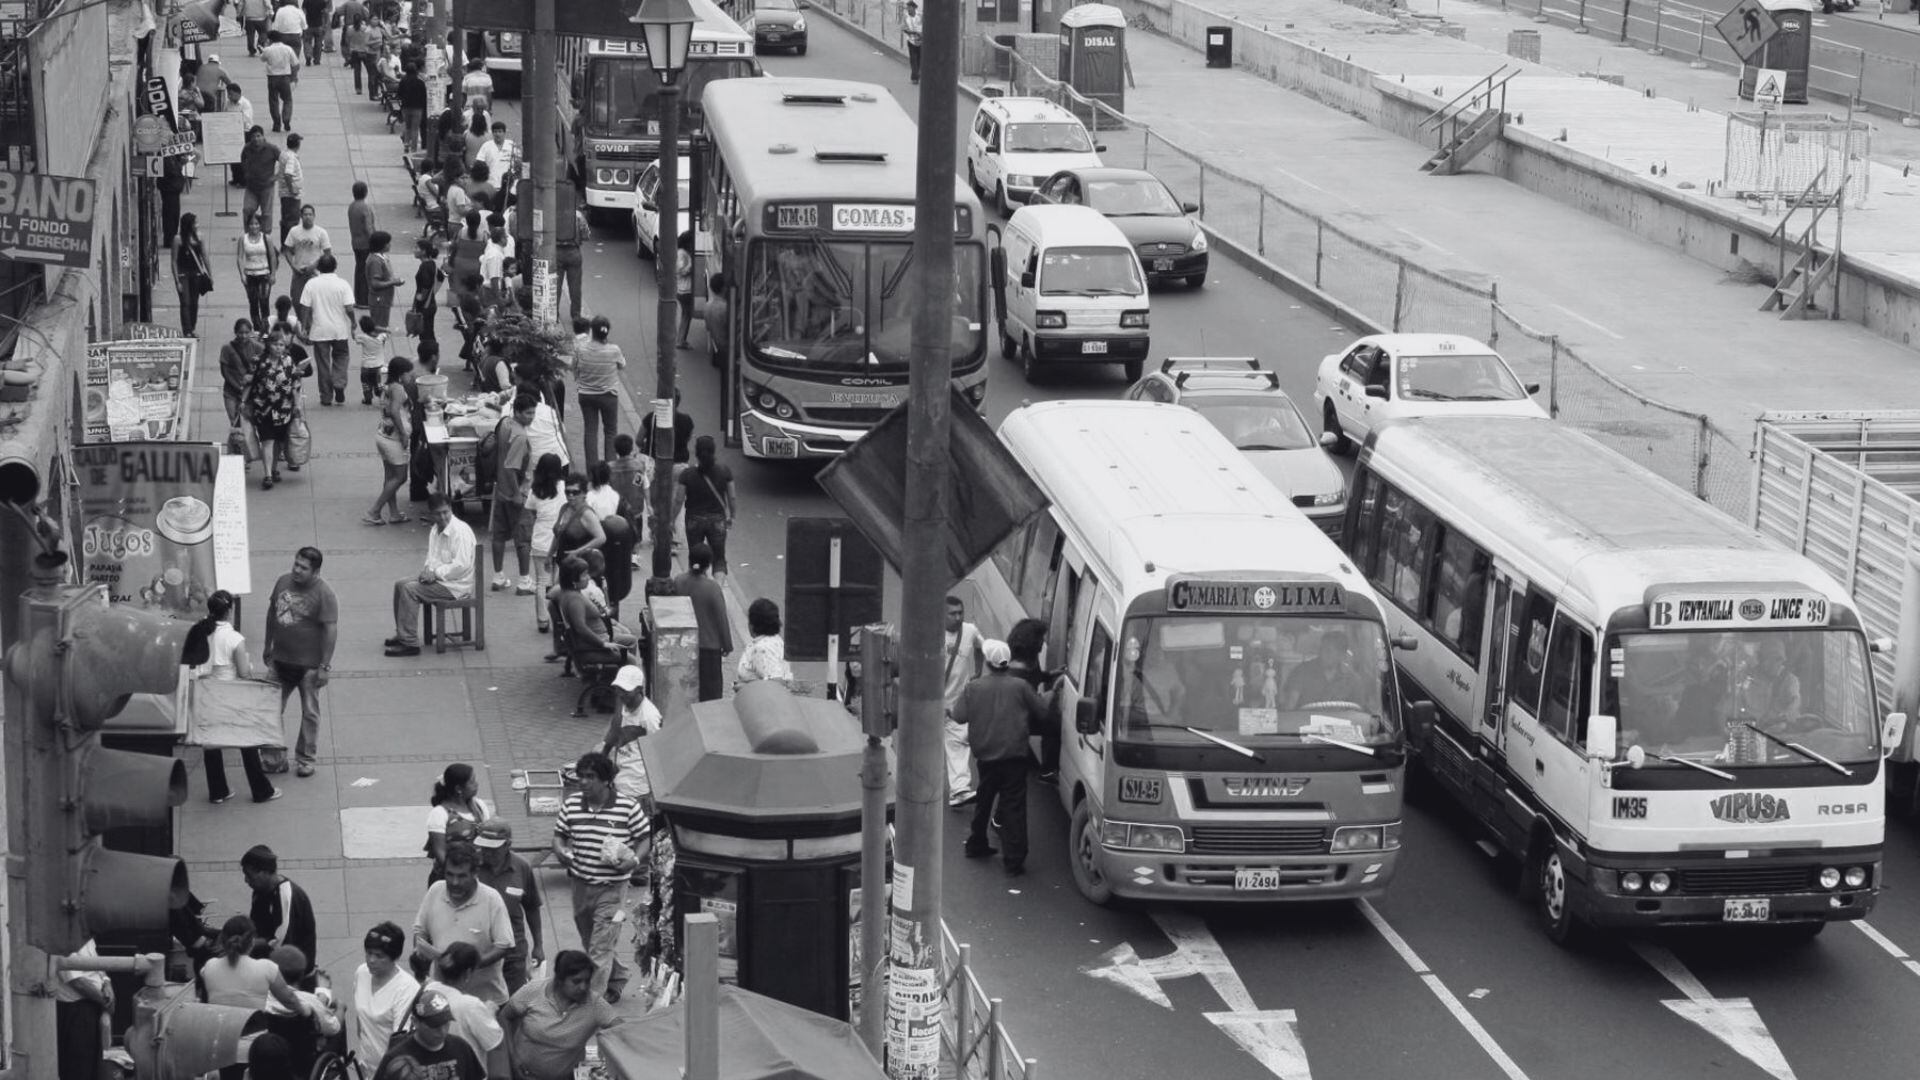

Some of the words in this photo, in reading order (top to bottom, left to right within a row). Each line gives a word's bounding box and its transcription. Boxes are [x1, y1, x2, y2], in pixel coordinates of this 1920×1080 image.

[1084, 36, 1116, 47] DISAL
[162, 143, 193, 155] FOTO
[19, 217, 69, 235] FONDO
[1, 231, 19, 245] LA
[26, 233, 89, 252] DERECHA
[841, 378, 893, 386] COMIL
[120, 450, 215, 483] GALLINA
[89, 468, 107, 486] DE
[84, 525, 153, 561] Jugos
[1281, 586, 1341, 606] LIMA
[1654, 601, 1673, 626] B
[1678, 599, 1734, 621] VENTANILLA
[1769, 598, 1804, 619] LINCE
[1807, 599, 1826, 622] 39
[1709, 792, 1791, 823] VIPUSA
[1818, 803, 1868, 815] ROSA
